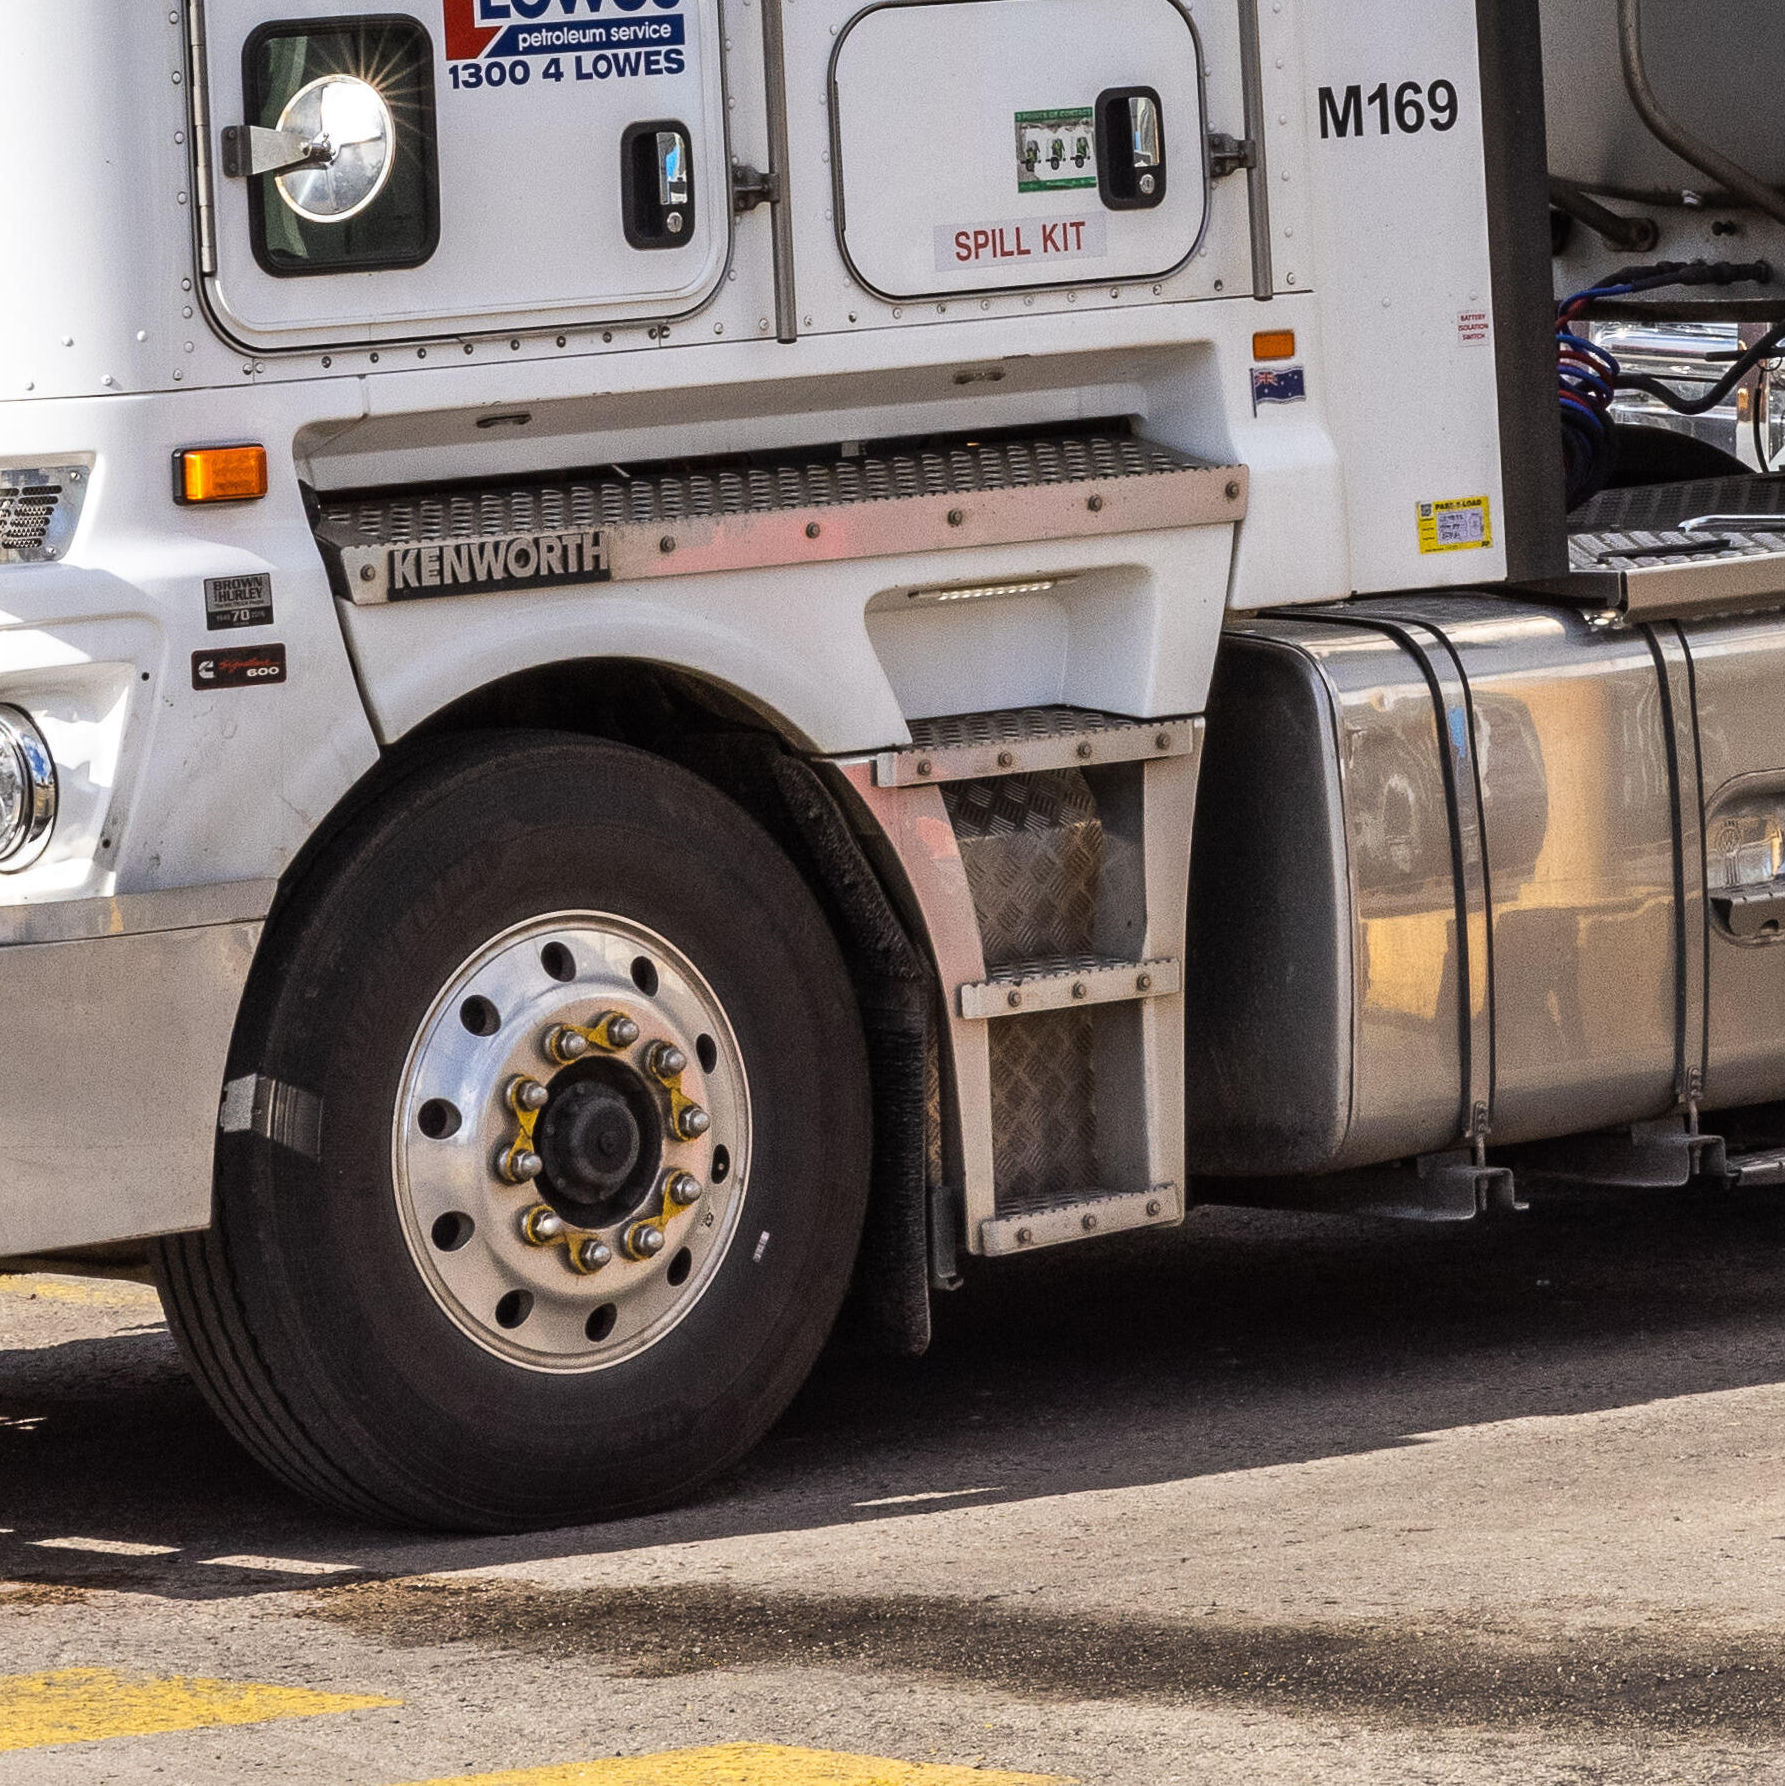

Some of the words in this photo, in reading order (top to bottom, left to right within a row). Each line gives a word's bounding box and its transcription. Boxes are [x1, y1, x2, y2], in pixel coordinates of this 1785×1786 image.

[518, 26, 606, 50] petroleum
[611, 22, 672, 42] service
[448, 59, 531, 89] 1300
[542, 58, 564, 81] 4
[575, 49, 686, 80] LOWES
[1319, 79, 1458, 140] M169
[954, 227, 1031, 262] SPILL
[1041, 221, 1086, 253] KIT
[394, 531, 610, 589] KENWORTH
[213, 576, 263, 591] BROWN
[219, 587, 263, 602] HURLEY
[232, 609, 250, 622] 70
[247, 666, 279, 677] 600
